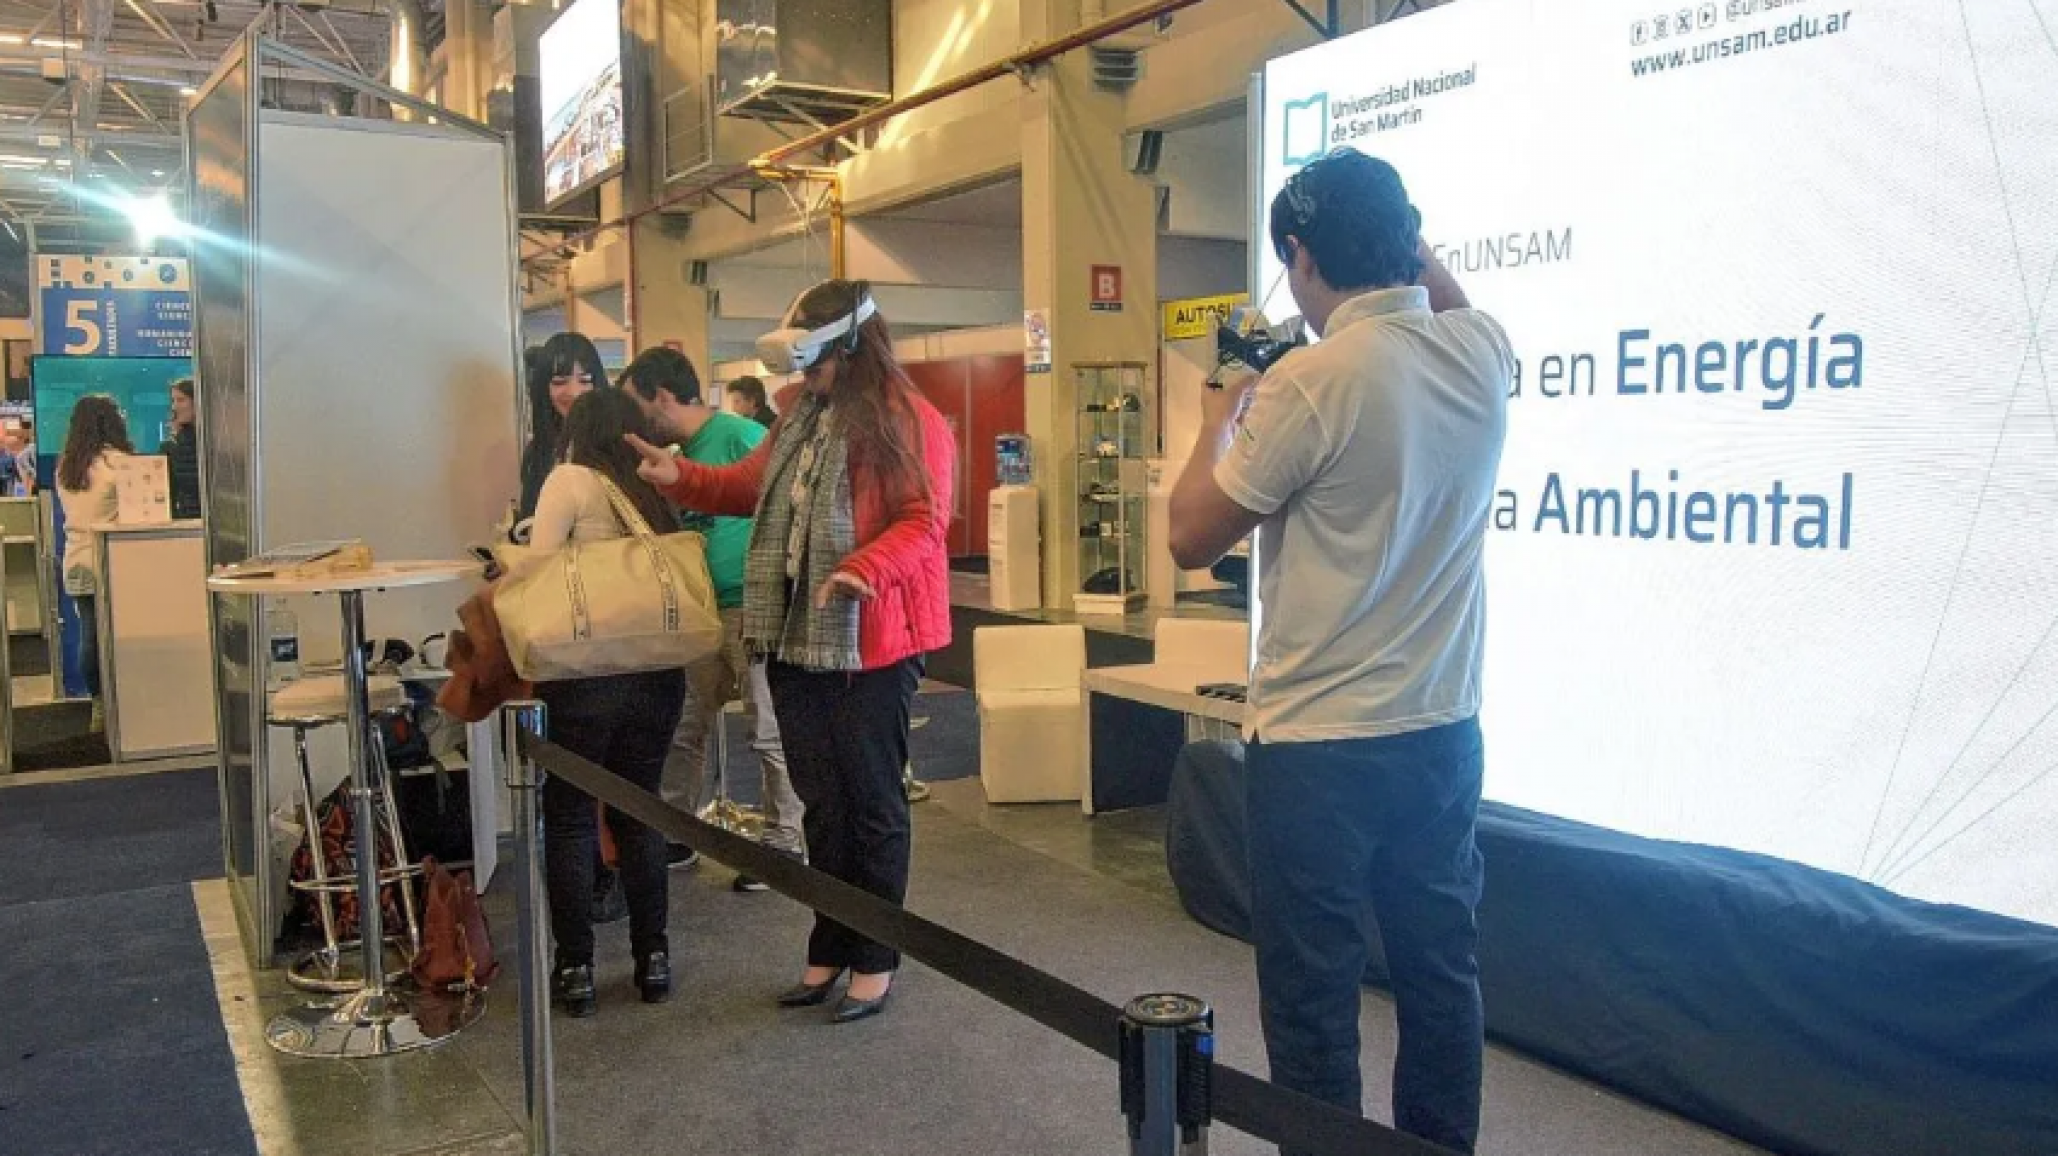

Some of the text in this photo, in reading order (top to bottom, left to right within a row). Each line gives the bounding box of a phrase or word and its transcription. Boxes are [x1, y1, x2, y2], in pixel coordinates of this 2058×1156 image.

[1631, 9, 1852, 77] www.unsam.edu.ar
[1331, 60, 1478, 119] Universidad Nacional
[1331, 123, 1347, 143] de
[1350, 118, 1375, 139] San
[1098, 273, 1115, 298] B
[63, 299, 101, 355] 5
[1539, 352, 1596, 398] en
[1616, 312, 1864, 411] Energía
[1532, 469, 1853, 551] Ambiental
